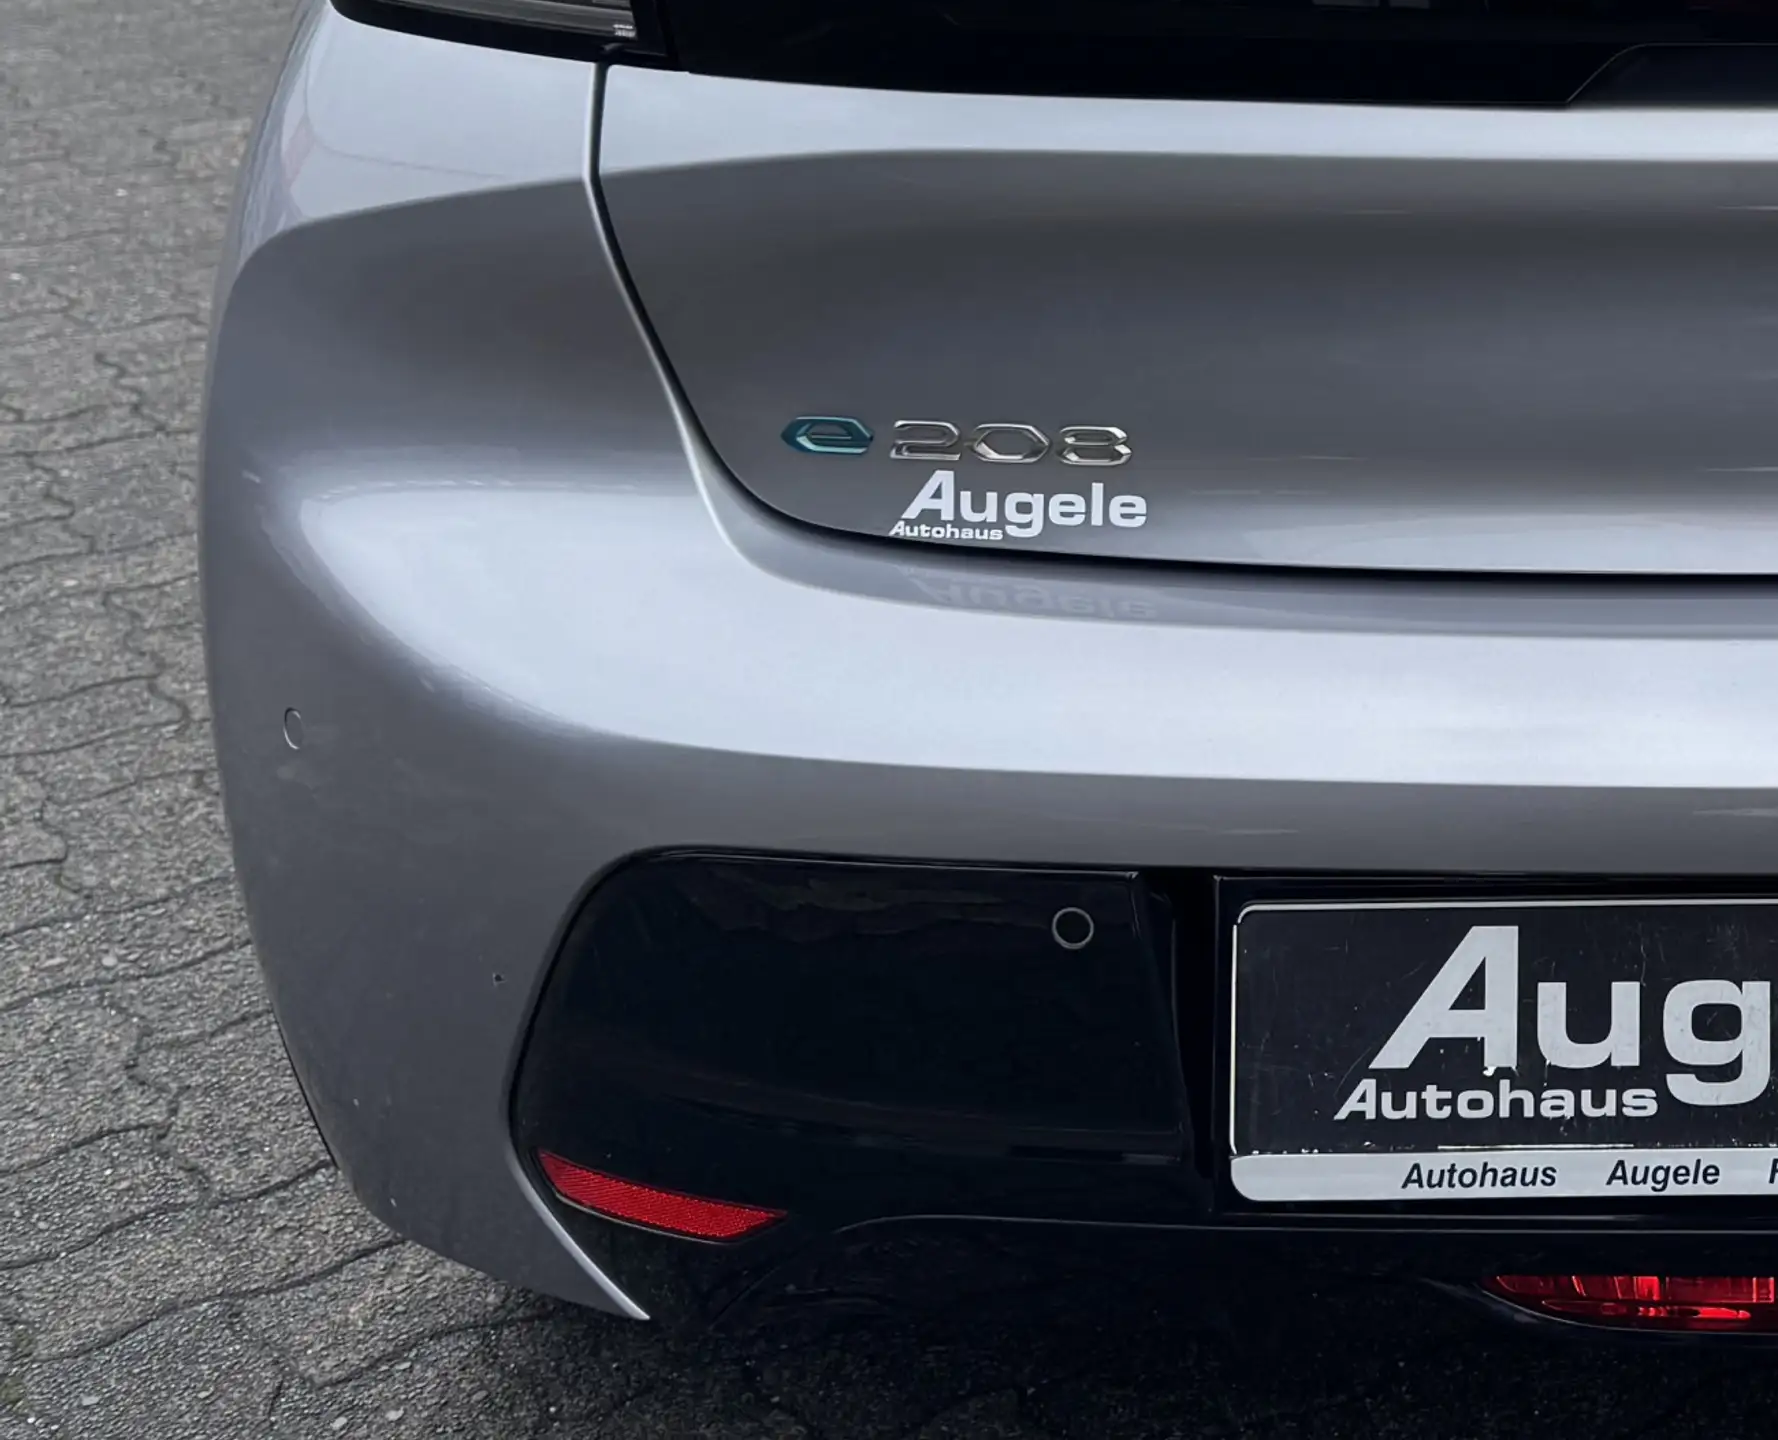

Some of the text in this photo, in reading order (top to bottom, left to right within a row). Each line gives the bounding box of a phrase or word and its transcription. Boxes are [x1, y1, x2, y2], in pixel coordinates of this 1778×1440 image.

[901, 469, 1148, 538] Augele
[888, 520, 1004, 541] Autohaus
[1333, 1079, 1659, 1122] Autohaus
[1401, 1162, 1558, 1191] Autohaus
[1605, 1159, 1721, 1192] Augele
